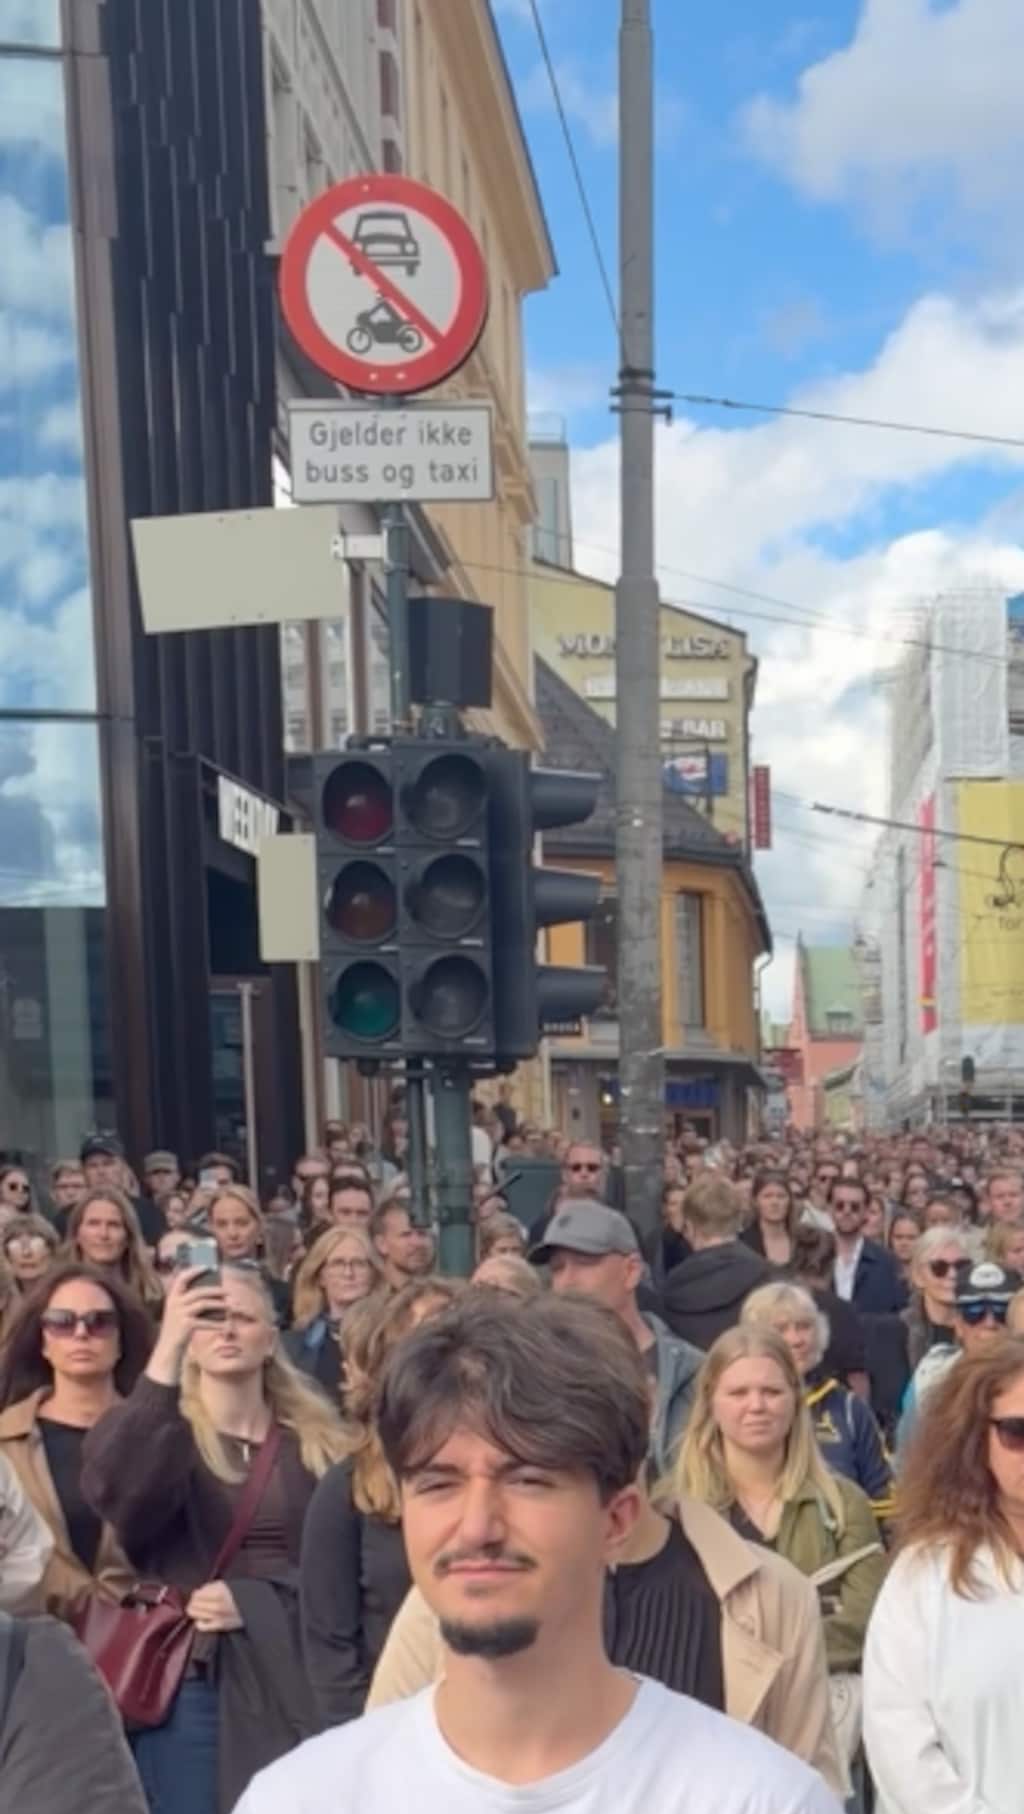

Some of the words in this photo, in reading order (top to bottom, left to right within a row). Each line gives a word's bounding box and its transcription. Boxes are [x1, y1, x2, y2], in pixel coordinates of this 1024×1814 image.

[308, 420, 406, 452] Gjelder
[418, 421, 472, 447] ikke
[305, 459, 369, 484] buss
[382, 463, 415, 489] og
[429, 457, 478, 482] taxi
